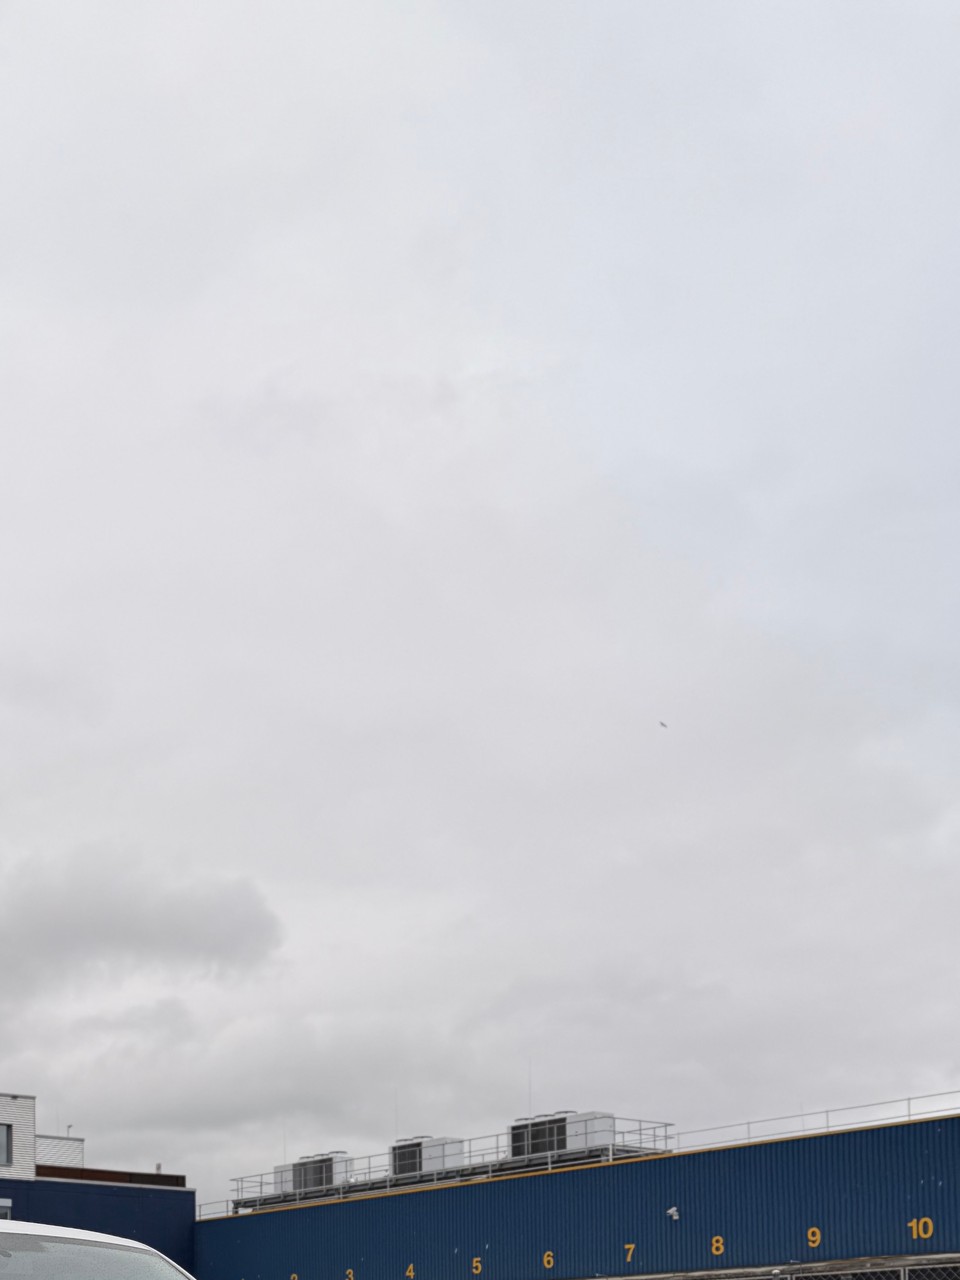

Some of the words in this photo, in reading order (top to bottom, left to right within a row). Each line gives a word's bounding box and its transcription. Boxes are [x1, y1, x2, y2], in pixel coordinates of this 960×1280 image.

[806, 1226, 822, 1249] 9
[906, 1216, 935, 1240] 10
[623, 1243, 636, 1263] 7
[711, 1235, 725, 1256] 8
[471, 1256, 483, 1275] 5
[542, 1250, 555, 1269] 6
[405, 1263, 415, 1280] 4
